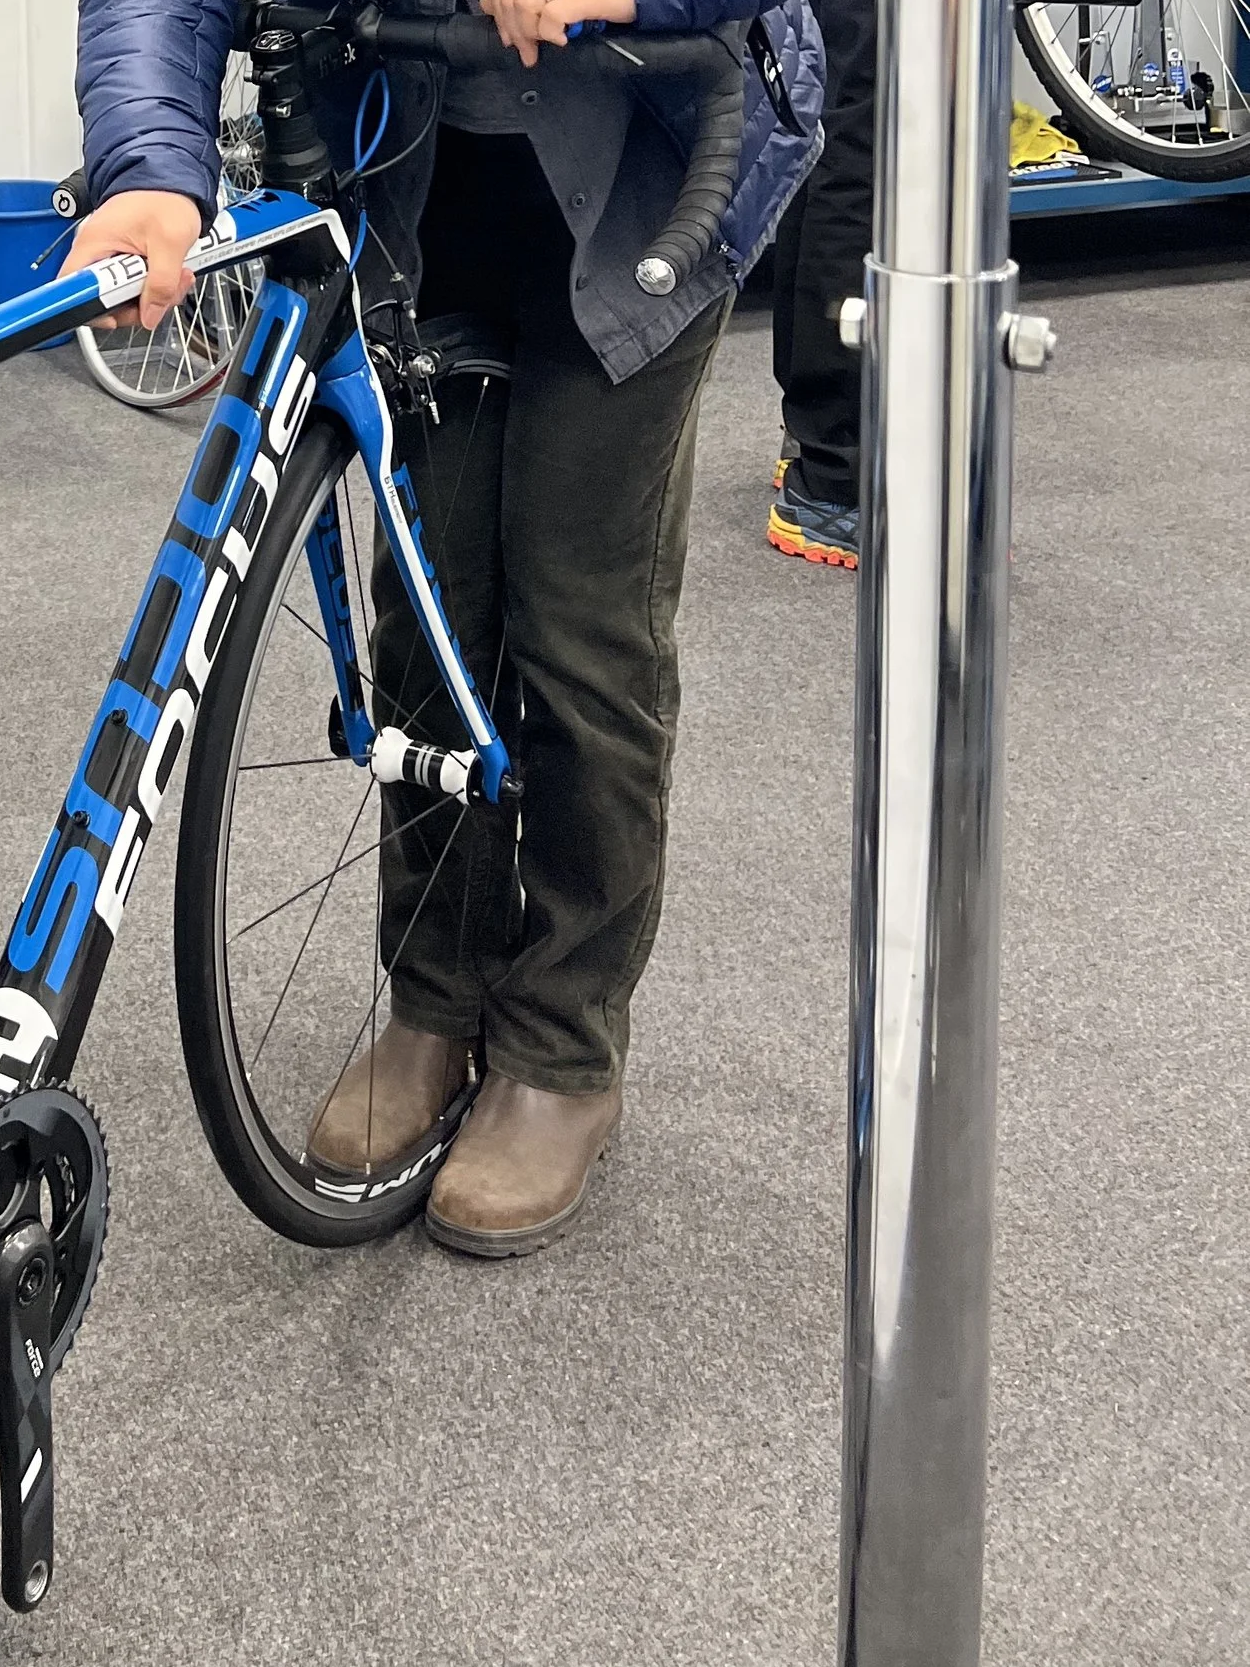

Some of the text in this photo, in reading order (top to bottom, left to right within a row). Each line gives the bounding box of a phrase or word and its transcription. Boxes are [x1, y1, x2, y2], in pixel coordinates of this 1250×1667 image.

[99, 253, 149, 286] TE
[9, 282, 308, 995] FOCUS
[94, 354, 318, 938] FOCUS
